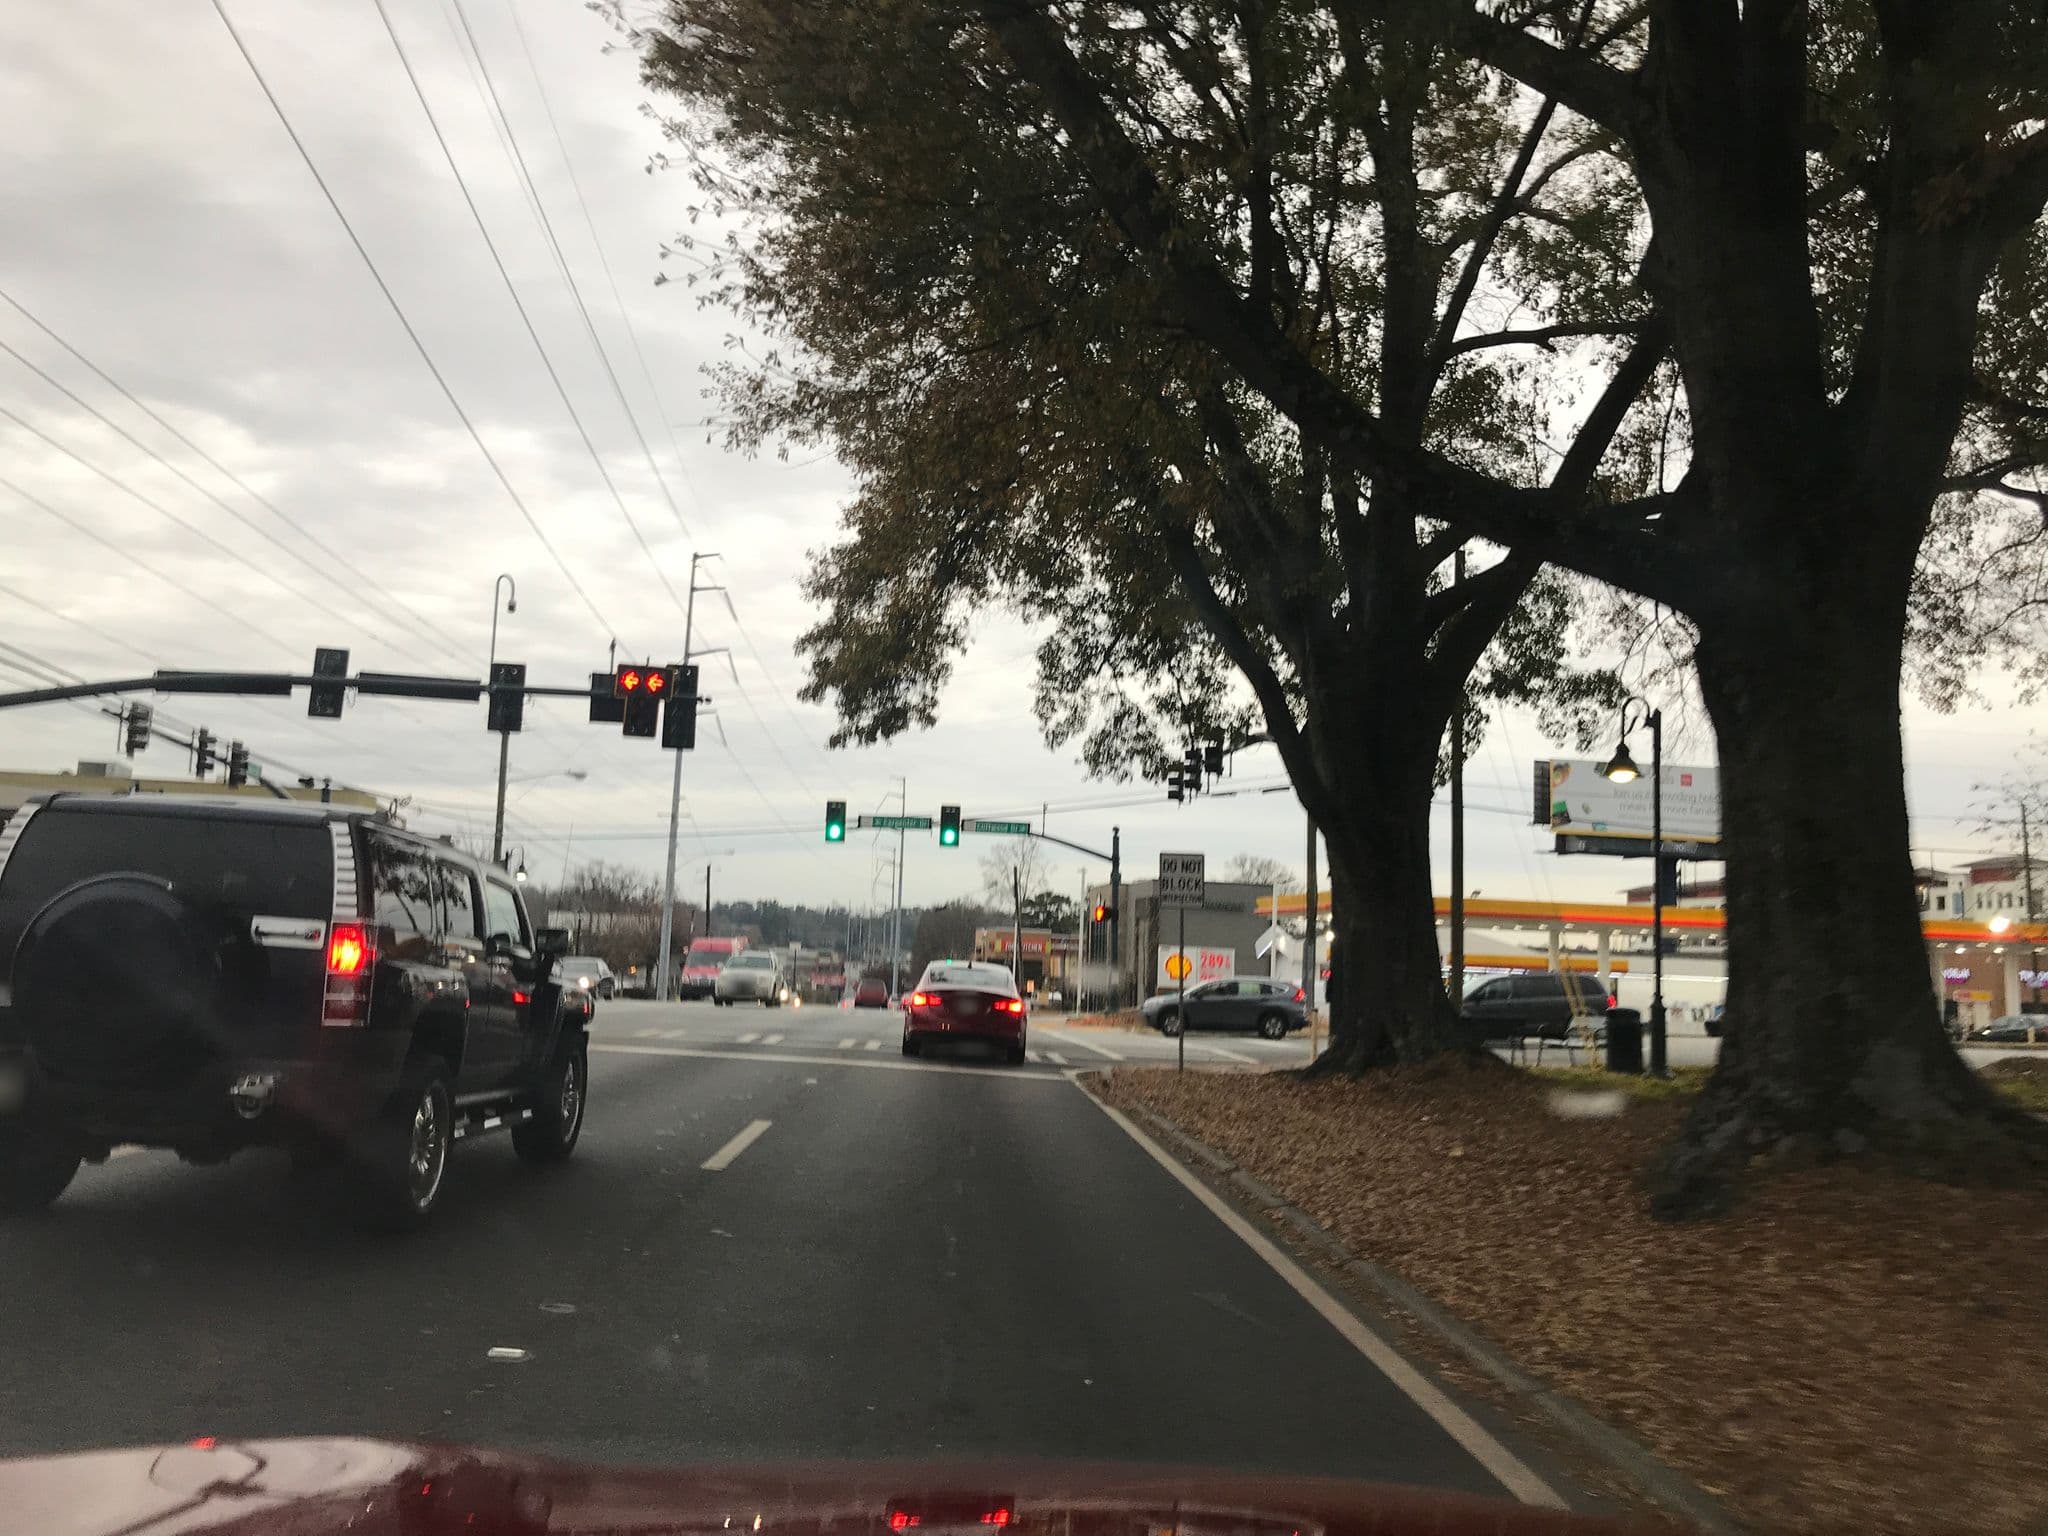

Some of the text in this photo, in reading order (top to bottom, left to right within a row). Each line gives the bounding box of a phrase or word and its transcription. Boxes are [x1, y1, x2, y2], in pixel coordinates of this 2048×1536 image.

[1162, 858, 1202, 874] DO NOT
[1162, 876, 1202, 891] BLOCK
